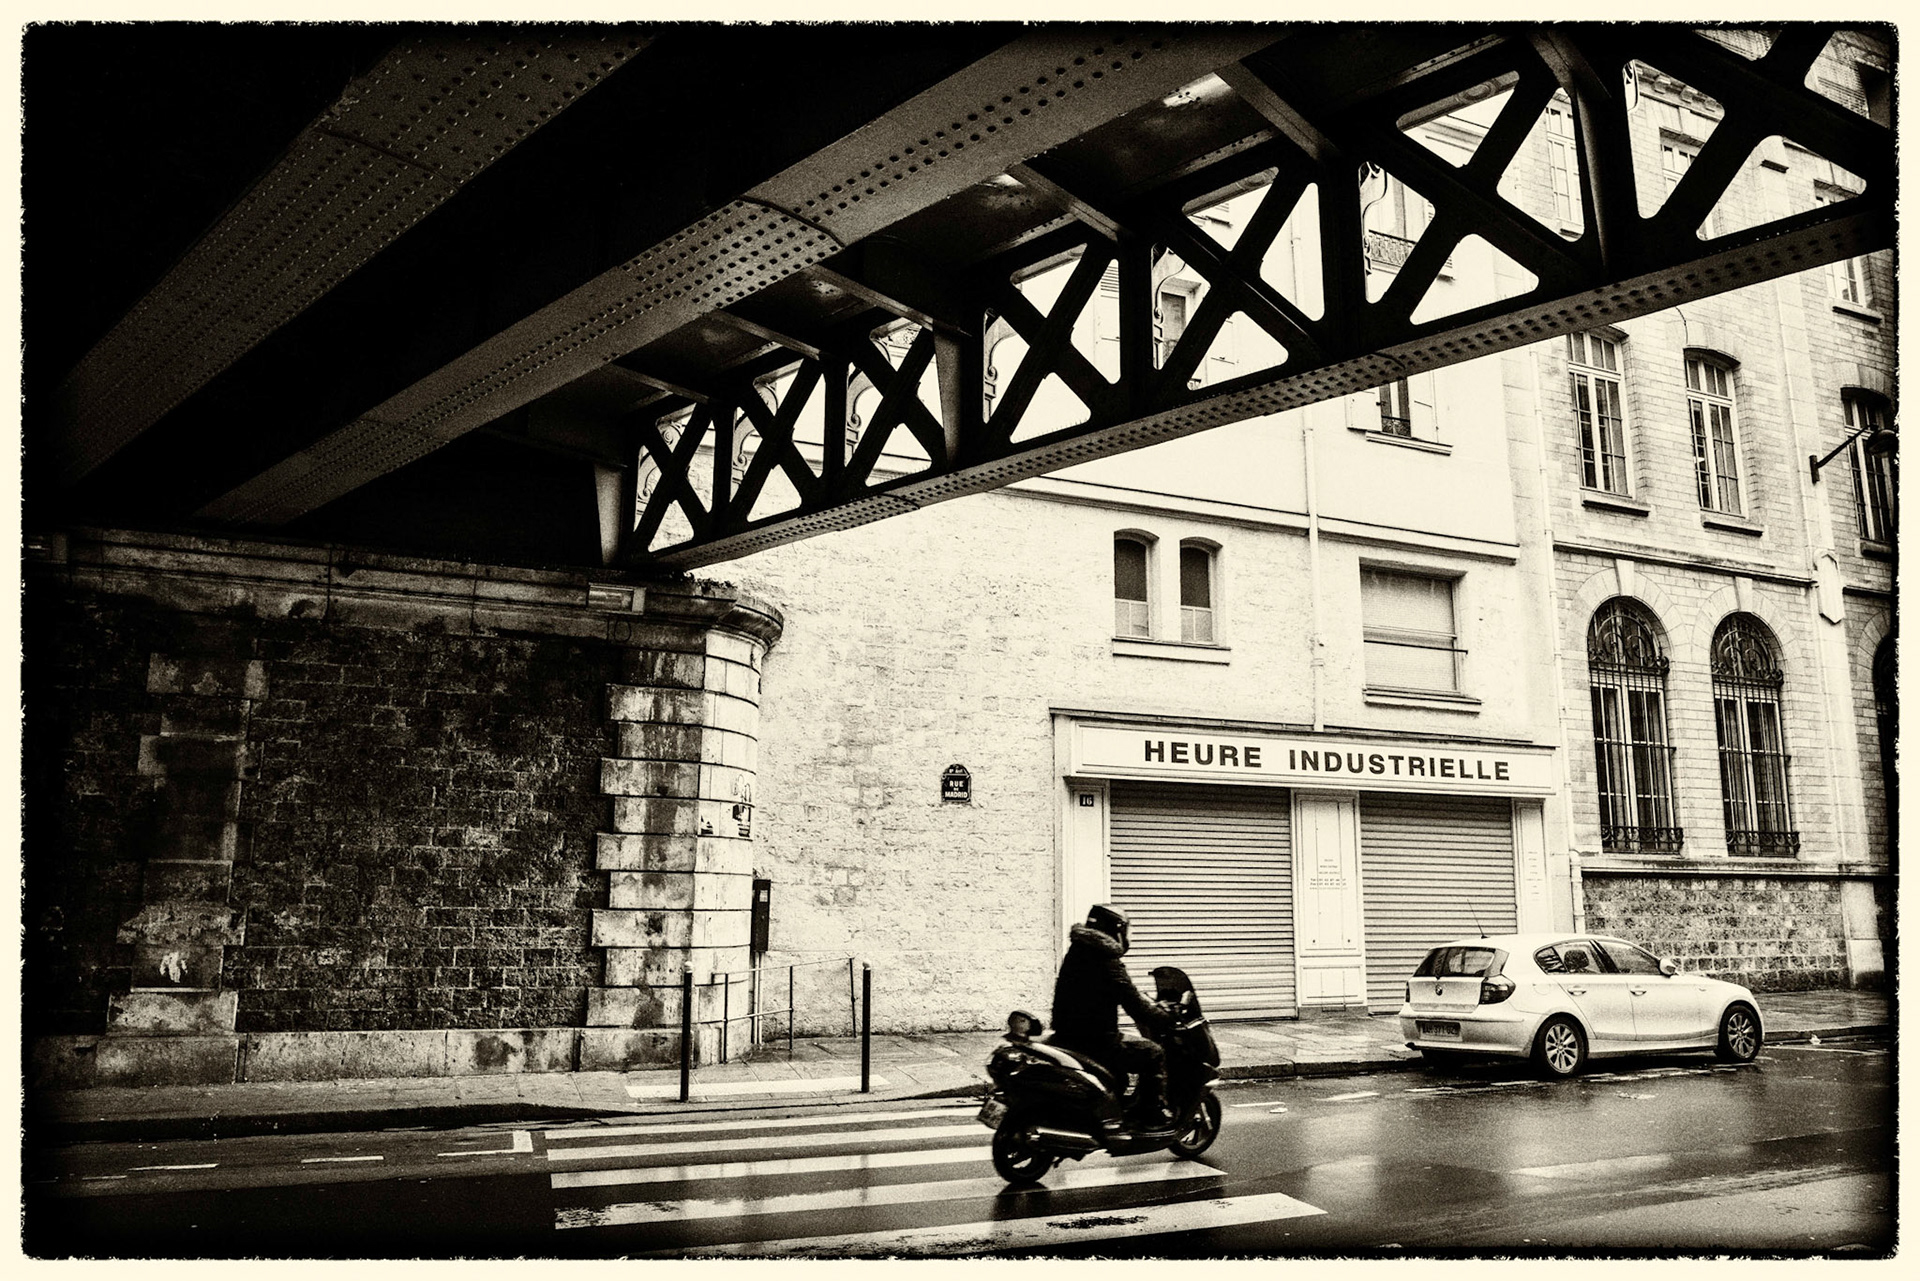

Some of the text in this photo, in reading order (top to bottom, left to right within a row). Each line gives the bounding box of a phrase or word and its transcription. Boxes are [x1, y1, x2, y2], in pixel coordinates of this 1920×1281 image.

[1144, 739, 1510, 781] HEURE INDUSTRIELLE
[1082, 796, 1093, 805] 16
